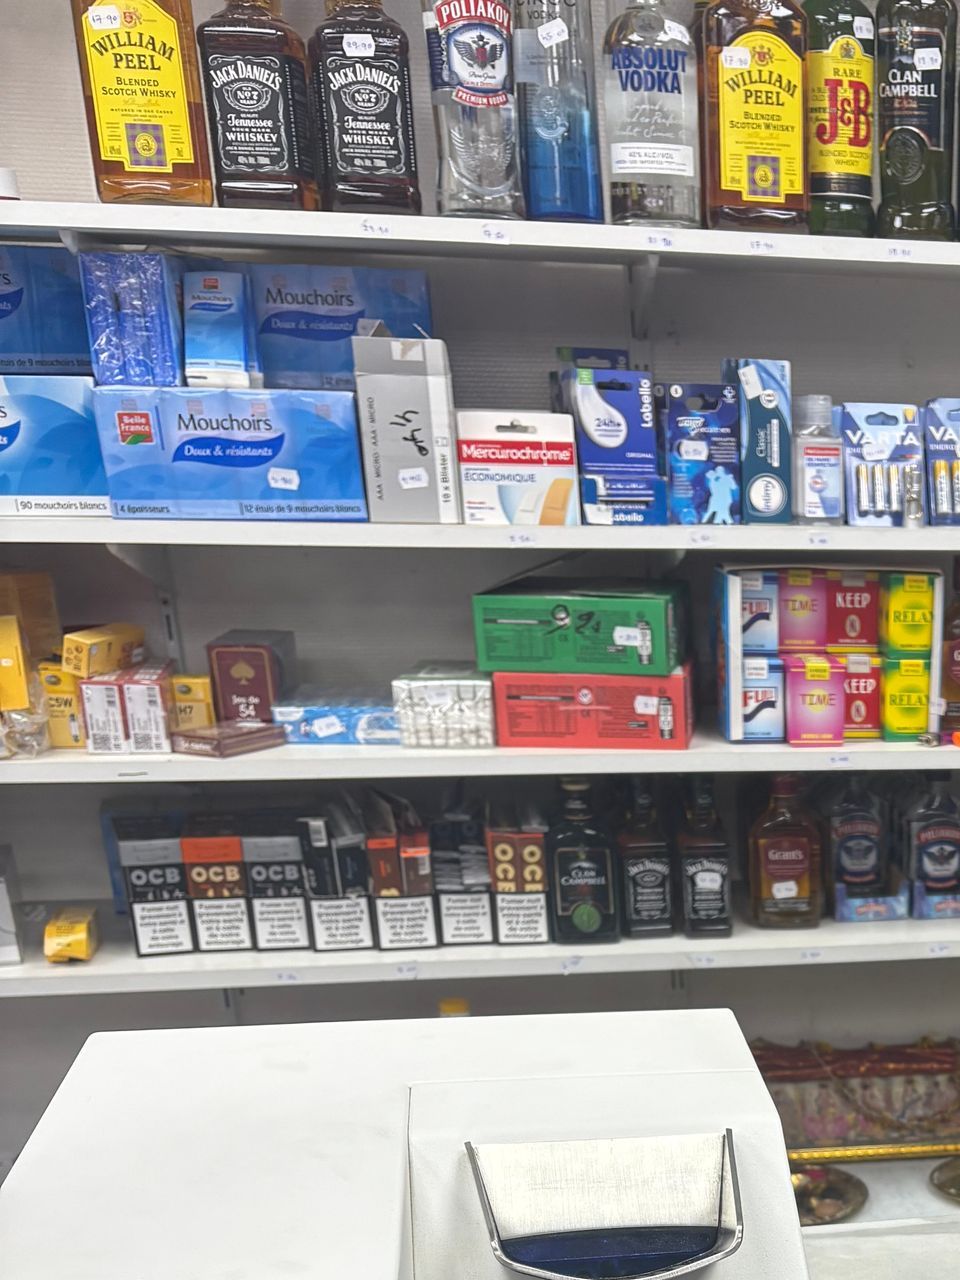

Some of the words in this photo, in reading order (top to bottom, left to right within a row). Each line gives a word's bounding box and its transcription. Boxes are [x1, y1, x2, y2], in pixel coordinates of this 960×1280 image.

[441, 0, 510, 26] POLIAKOV
[91, 31, 175, 62] WILLIAM
[112, 52, 161, 71] PEEL
[612, 48, 688, 72] ABSOLUT
[210, 64, 237, 88] JACK
[237, 61, 283, 90] DANIEL'S
[328, 67, 355, 91] JACK
[355, 64, 401, 94] DANIEL'S
[833, 68, 862, 79] RARE
[888, 69, 922, 83] CLAN
[116, 77, 159, 87] BLENDED
[618, 70, 682, 95] VODKA
[725, 70, 798, 97] WILLIAM
[880, 82, 938, 97] CAMPBELL
[101, 86, 137, 97] SCOTCH
[140, 87, 176, 98] WHISKY
[744, 89, 785, 106] PEEL
[227, 113, 273, 128] Tennessee
[744, 112, 782, 121] BLENDED
[816, 79, 871, 148] J&B
[344, 116, 391, 131] Tennessee
[729, 120, 761, 129] SCOTCH
[763, 122, 795, 133] WHISKY
[226, 132, 278, 143] WHISKEY
[342, 135, 396, 146] WHISKEY
[265, 288, 354, 307] Mouchoirs
[271, 319, 296, 330] Doux
[122, 415, 147, 425] Belle
[177, 413, 273, 432] Mouchoirs
[119, 424, 150, 434] France
[844, 429, 921, 446] VARTA
[184, 446, 211, 457] Doux
[213, 446, 223, 457] &
[225, 446, 273, 458] résistants
[462, 443, 571, 463] Mercurochrome
[20, 501, 32, 510] 90
[34, 500, 78, 510] mouchoirs
[79, 501, 107, 510] blancs
[119, 504, 125, 513] 4
[127, 503, 170, 515] épaisseurs
[275, 504, 285, 513] de
[294, 503, 334, 514] mouchoirs
[836, 592, 871, 609] KEEP
[130, 868, 181, 886] OCB
[191, 865, 240, 883] OCB
[251, 865, 299, 882] OCB
